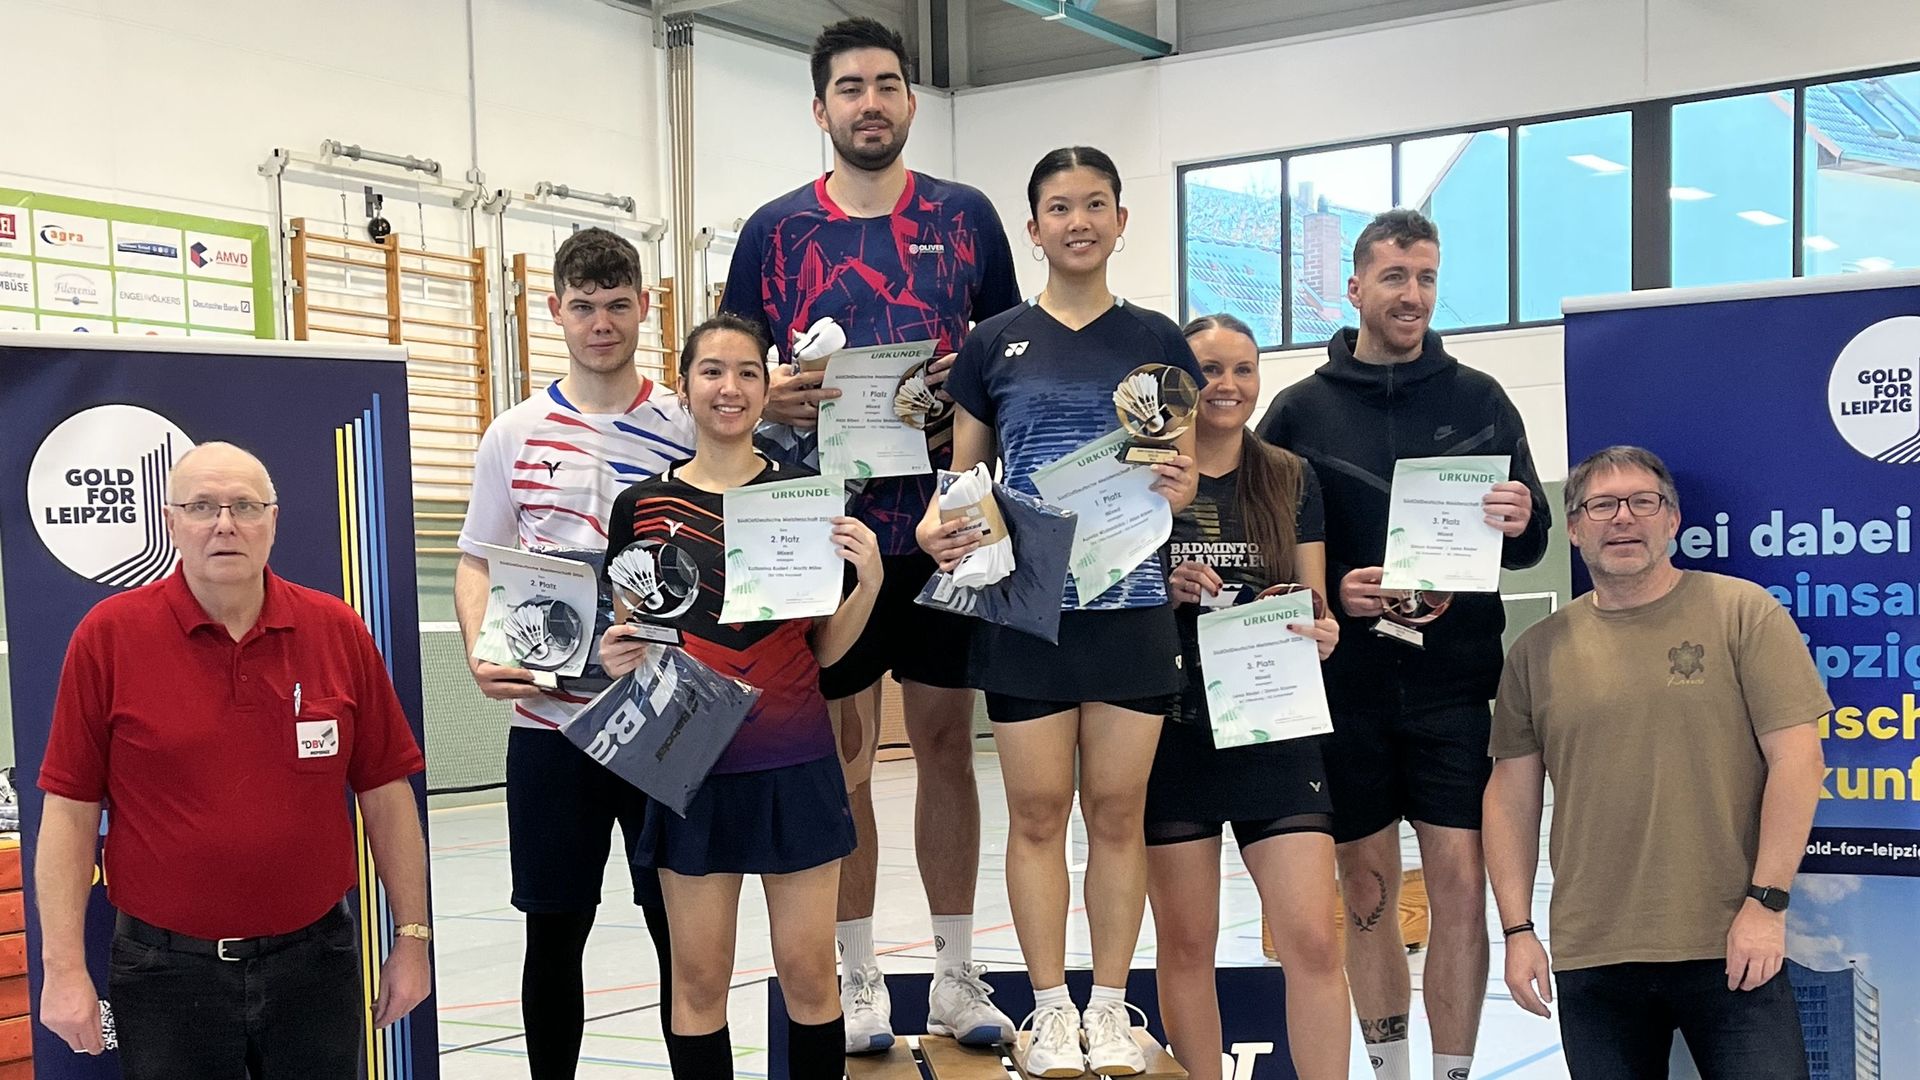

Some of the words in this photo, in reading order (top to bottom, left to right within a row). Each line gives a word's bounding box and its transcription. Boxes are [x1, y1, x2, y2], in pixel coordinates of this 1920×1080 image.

[51, 230, 84, 242] agra
[216, 250, 248, 264] AMVD
[193, 299, 222, 310] Deutsche
[223, 303, 239, 312] Bank
[871, 350, 922, 359] URKUNDE
[1858, 368, 1912, 384] GOLD
[1874, 384, 1912, 398] FOR
[1841, 398, 1912, 416] LEIPZIG
[1077, 440, 1129, 467] URKUND
[65, 469, 134, 486] GOLD
[1439, 473, 1495, 483] URKUNDE
[87, 487, 136, 505] FOR
[772, 488, 830, 499] URKUNDE
[1103, 491, 1121, 504] Platz
[45, 506, 136, 524] LEIPZIG
[1749, 506, 1911, 557] dabei
[1170, 543, 1262, 554] BADMINTO
[539, 581, 557, 590] Platz
[1764, 571, 1920, 617] einsa
[1243, 610, 1299, 626] URKUNDE
[1247, 662, 1254, 670] 3.
[1256, 660, 1275, 668] Platz
[306, 739, 324, 749] DBV
[1803, 842, 1920, 861] old-for-leipzi
